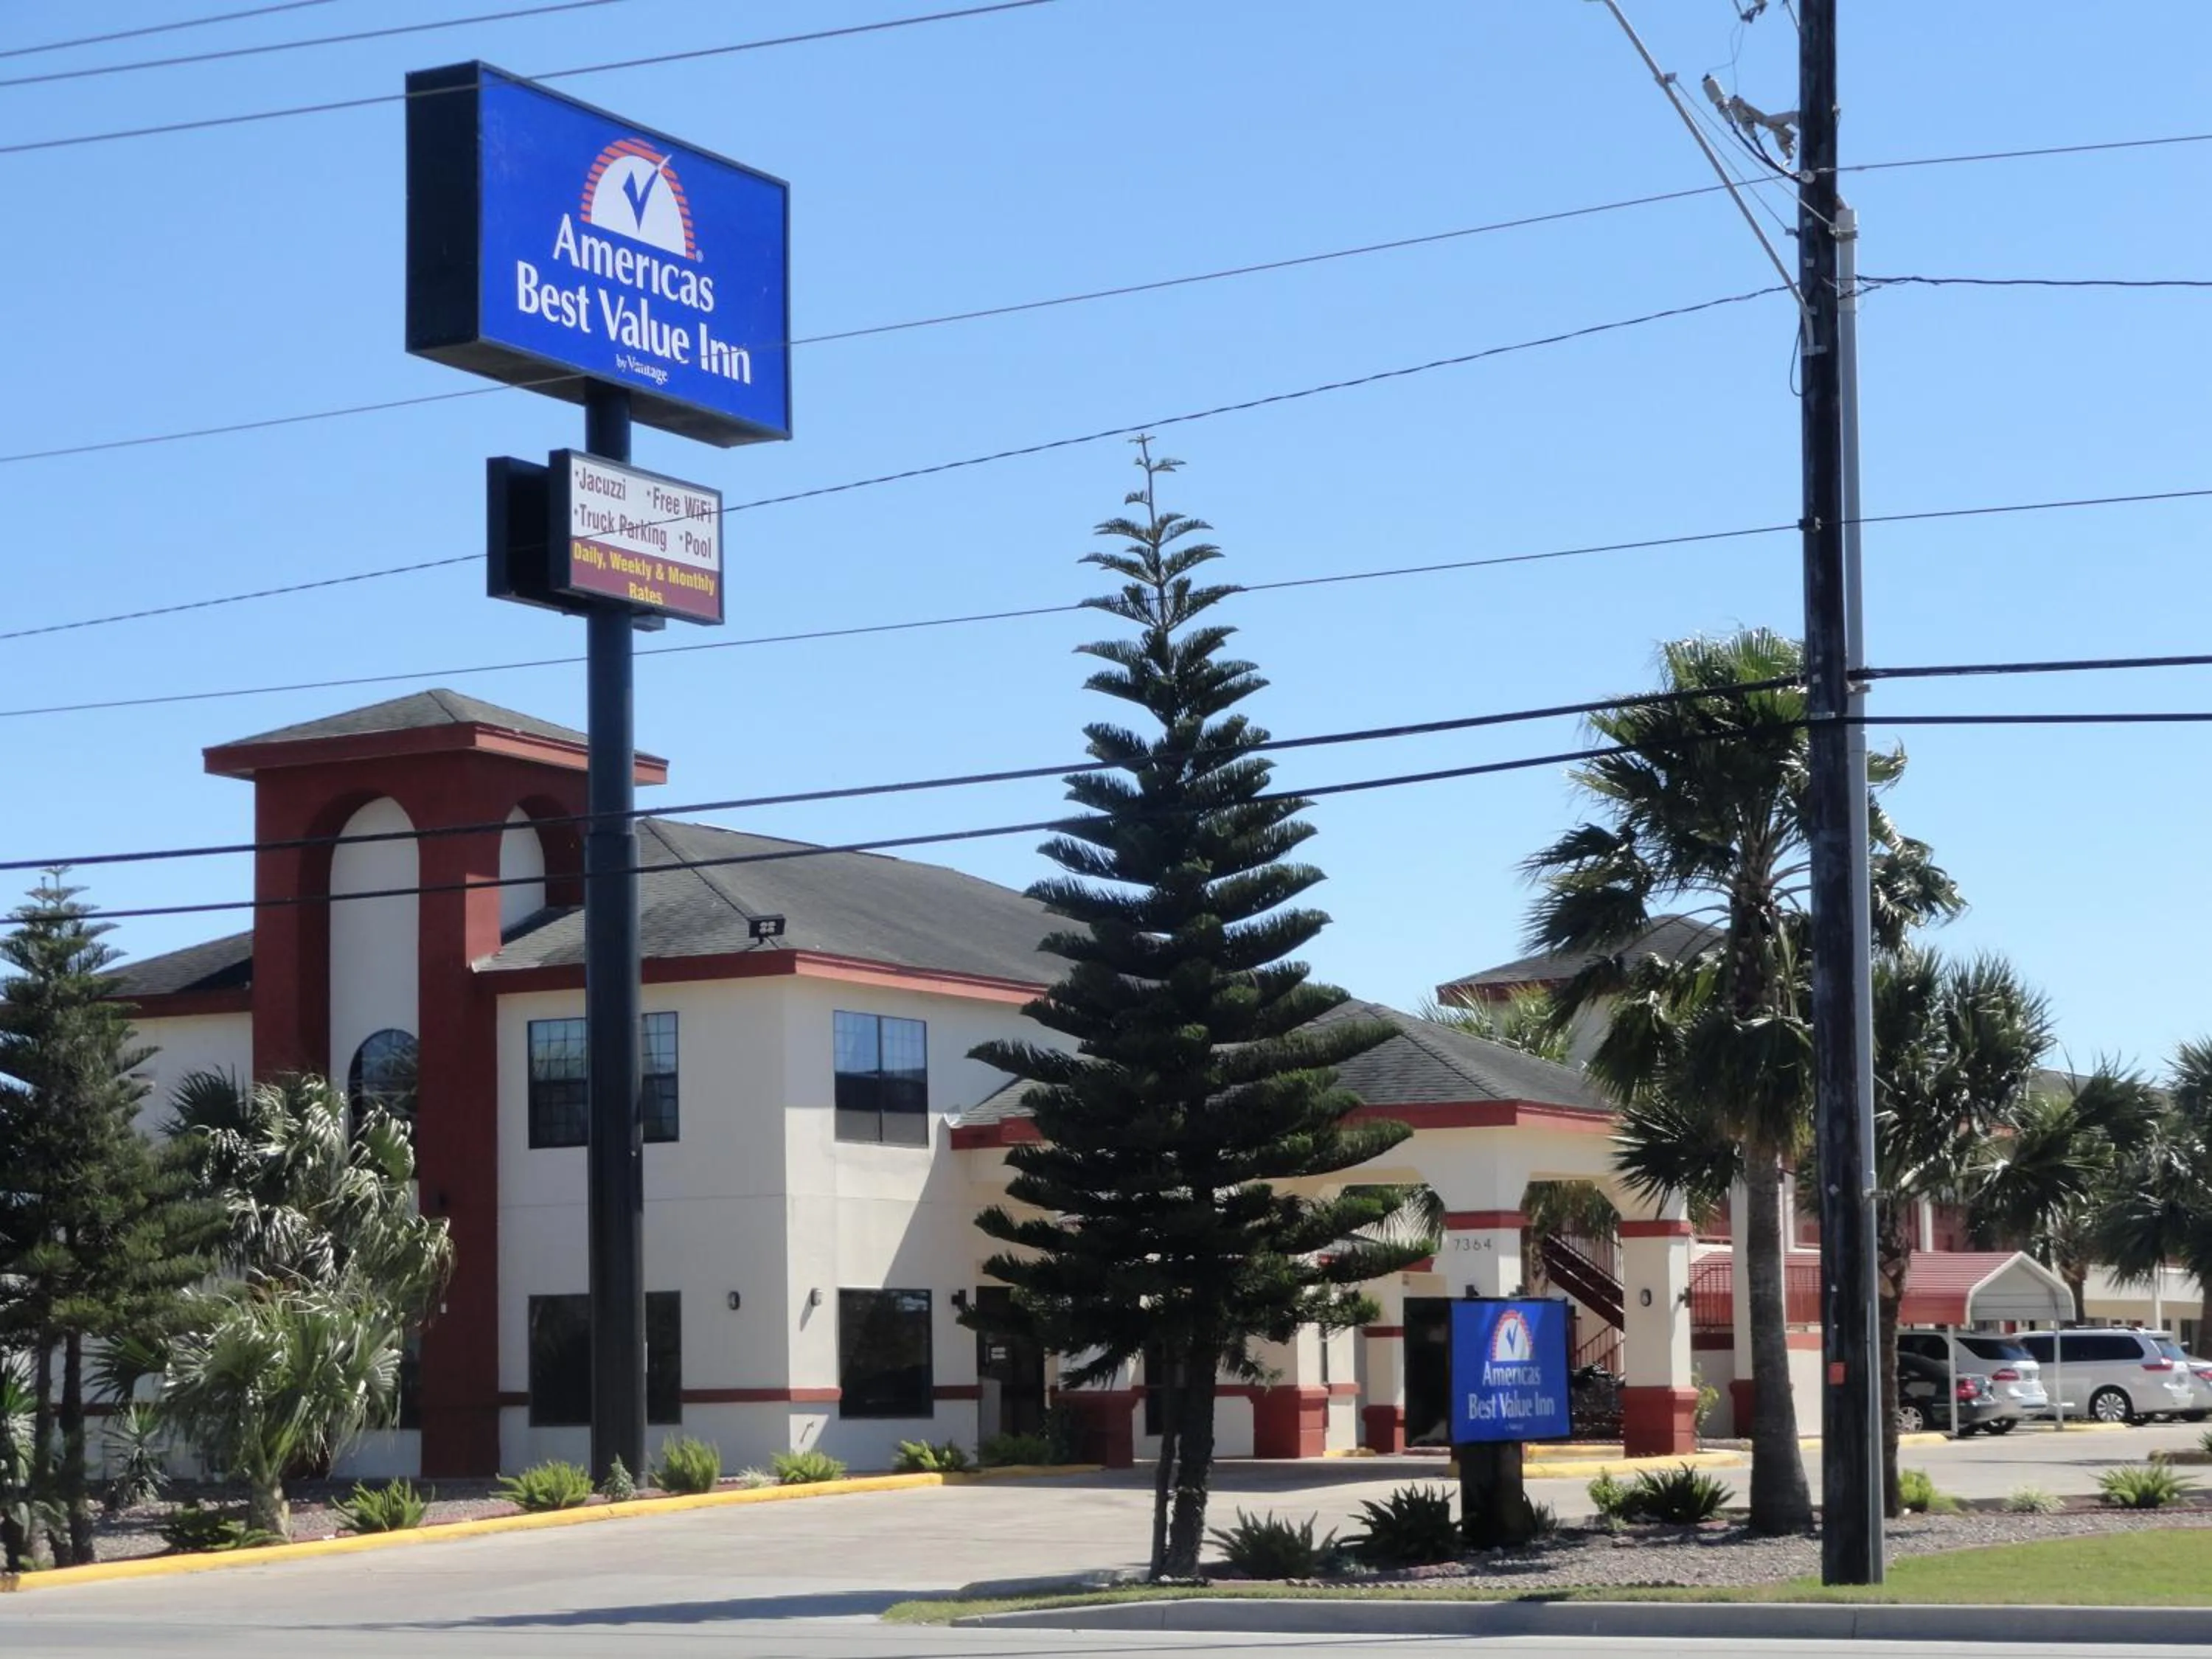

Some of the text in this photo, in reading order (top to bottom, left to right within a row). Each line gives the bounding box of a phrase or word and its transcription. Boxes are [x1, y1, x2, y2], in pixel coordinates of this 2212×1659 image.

[553, 213, 714, 313] Americas
[518, 260, 751, 384] Best Value Inn
[653, 486, 680, 515] Free
[580, 504, 712, 559] Truck Parking Pool
[573, 542, 714, 596] Daily, Weekly & Monthly
[628, 582, 663, 605] Rates
[1453, 1238, 1492, 1252] 7364
[1482, 1360, 1541, 1386] Americas
[1468, 1389, 1555, 1420] Best Value Inn
